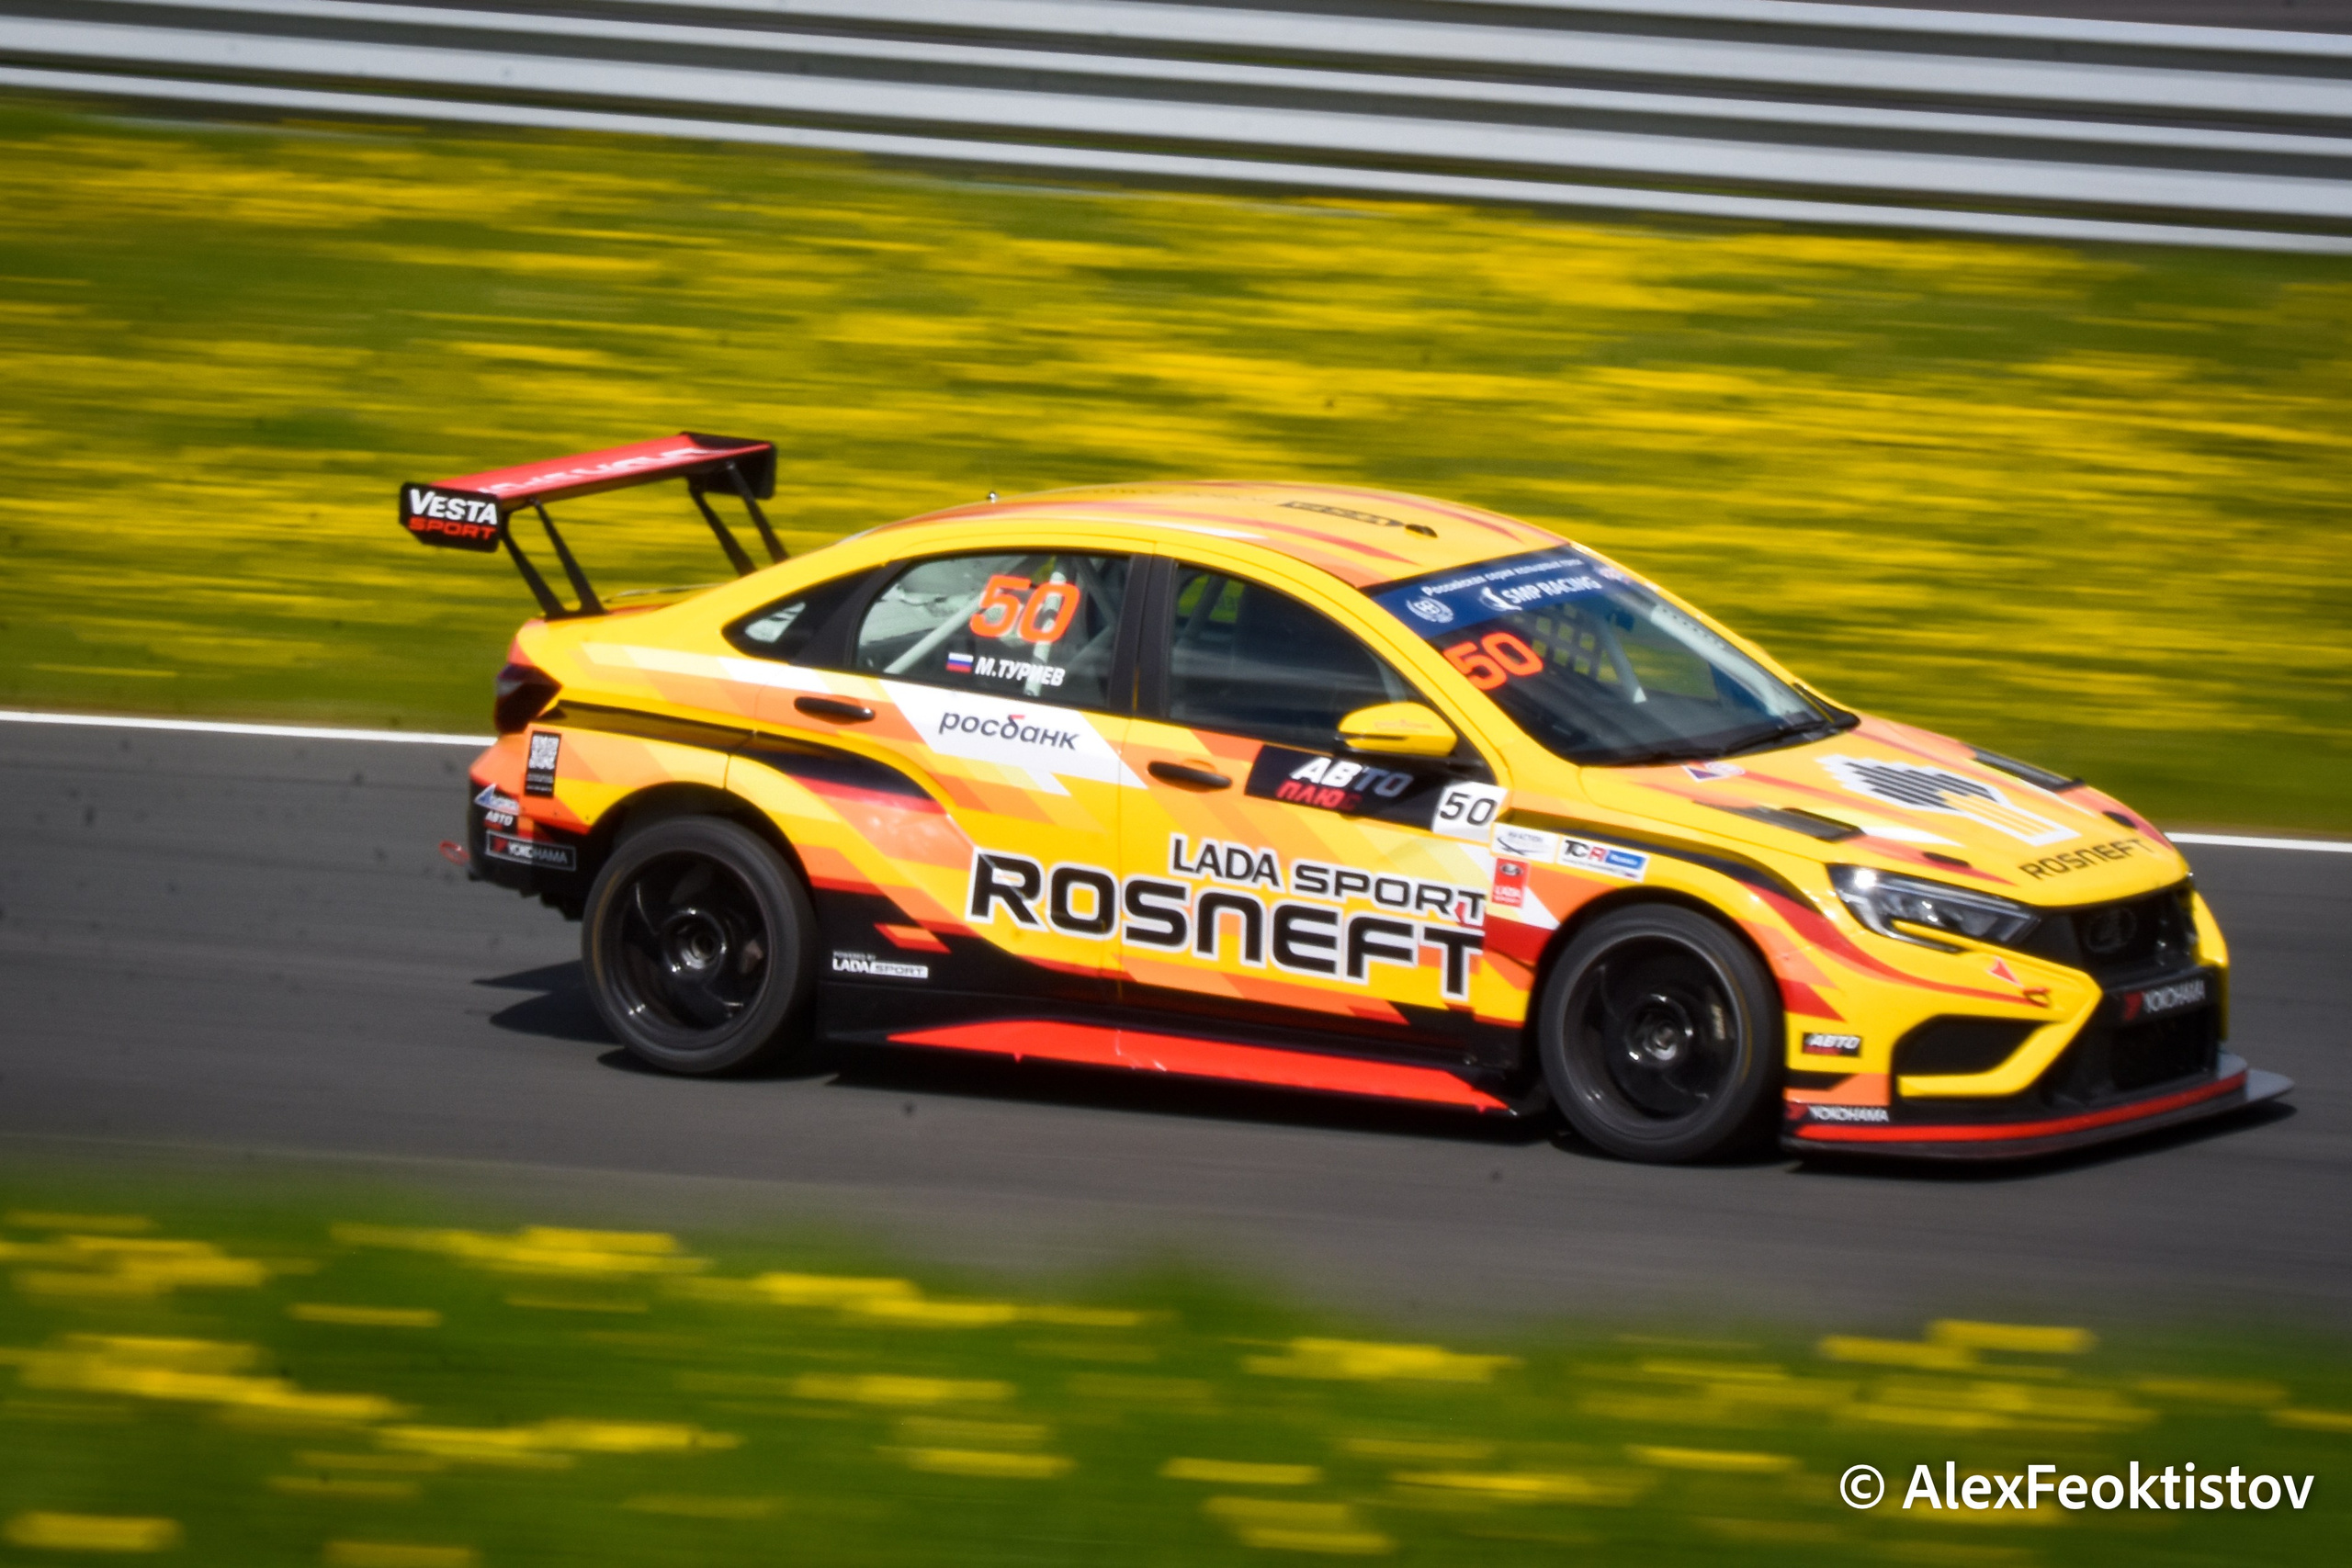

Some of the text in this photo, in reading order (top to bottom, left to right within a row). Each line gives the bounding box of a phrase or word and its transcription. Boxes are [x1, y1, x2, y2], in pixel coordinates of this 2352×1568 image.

[409, 489, 498, 525] VESTA
[407, 517, 497, 540] SPORT
[1500, 584, 1542, 604] SMP
[1536, 575, 1603, 597] RACING
[969, 574, 1080, 643] 50
[1443, 631, 1544, 691] 50
[938, 712, 1080, 750] росбанк
[1289, 756, 1415, 798] АВТО
[1275, 780, 1363, 811] ПЛЮС
[1439, 791, 1498, 827] 50
[508, 841, 568, 863] YOKOHAMA
[1564, 839, 1608, 862] TCR
[2019, 837, 2152, 879] ROSNEFT
[1170, 833, 1486, 924] LADA SPORT
[967, 849, 1485, 1000] ROSNEFT
[832, 959, 922, 976] LADA SPORT
[1804, 1033, 1861, 1049] АВТО
[1807, 1105, 1890, 1122] YOKOHAMA
